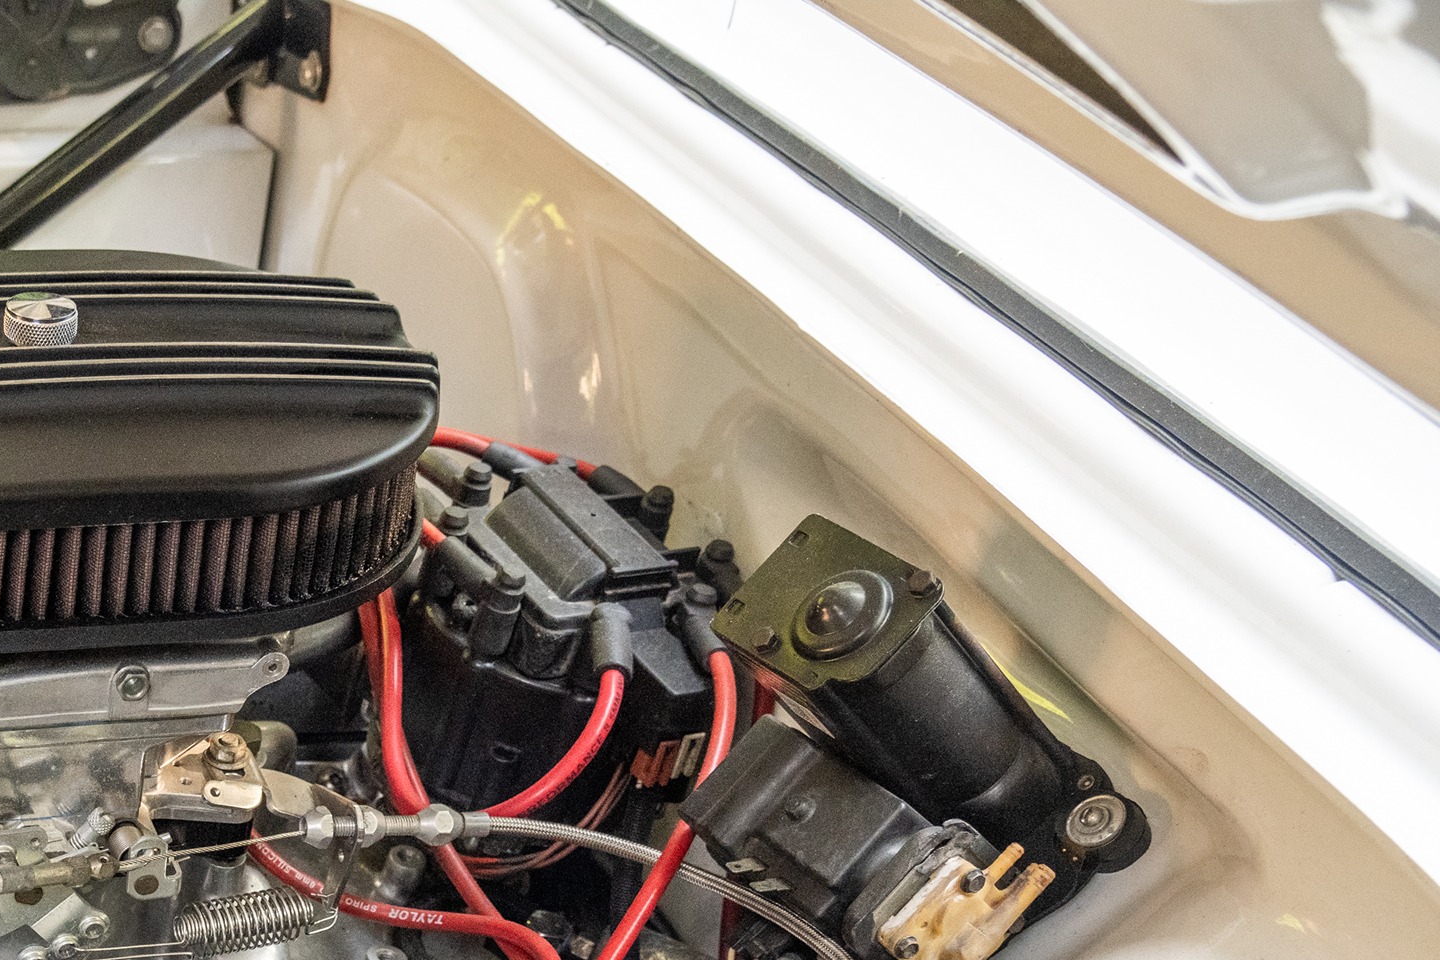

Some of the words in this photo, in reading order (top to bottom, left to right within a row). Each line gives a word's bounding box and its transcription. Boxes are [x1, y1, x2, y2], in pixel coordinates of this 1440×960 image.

[256, 842, 292, 874] SILICON
[345, 897, 377, 912] SPIRO
[388, 907, 444, 925] TAYLOR
